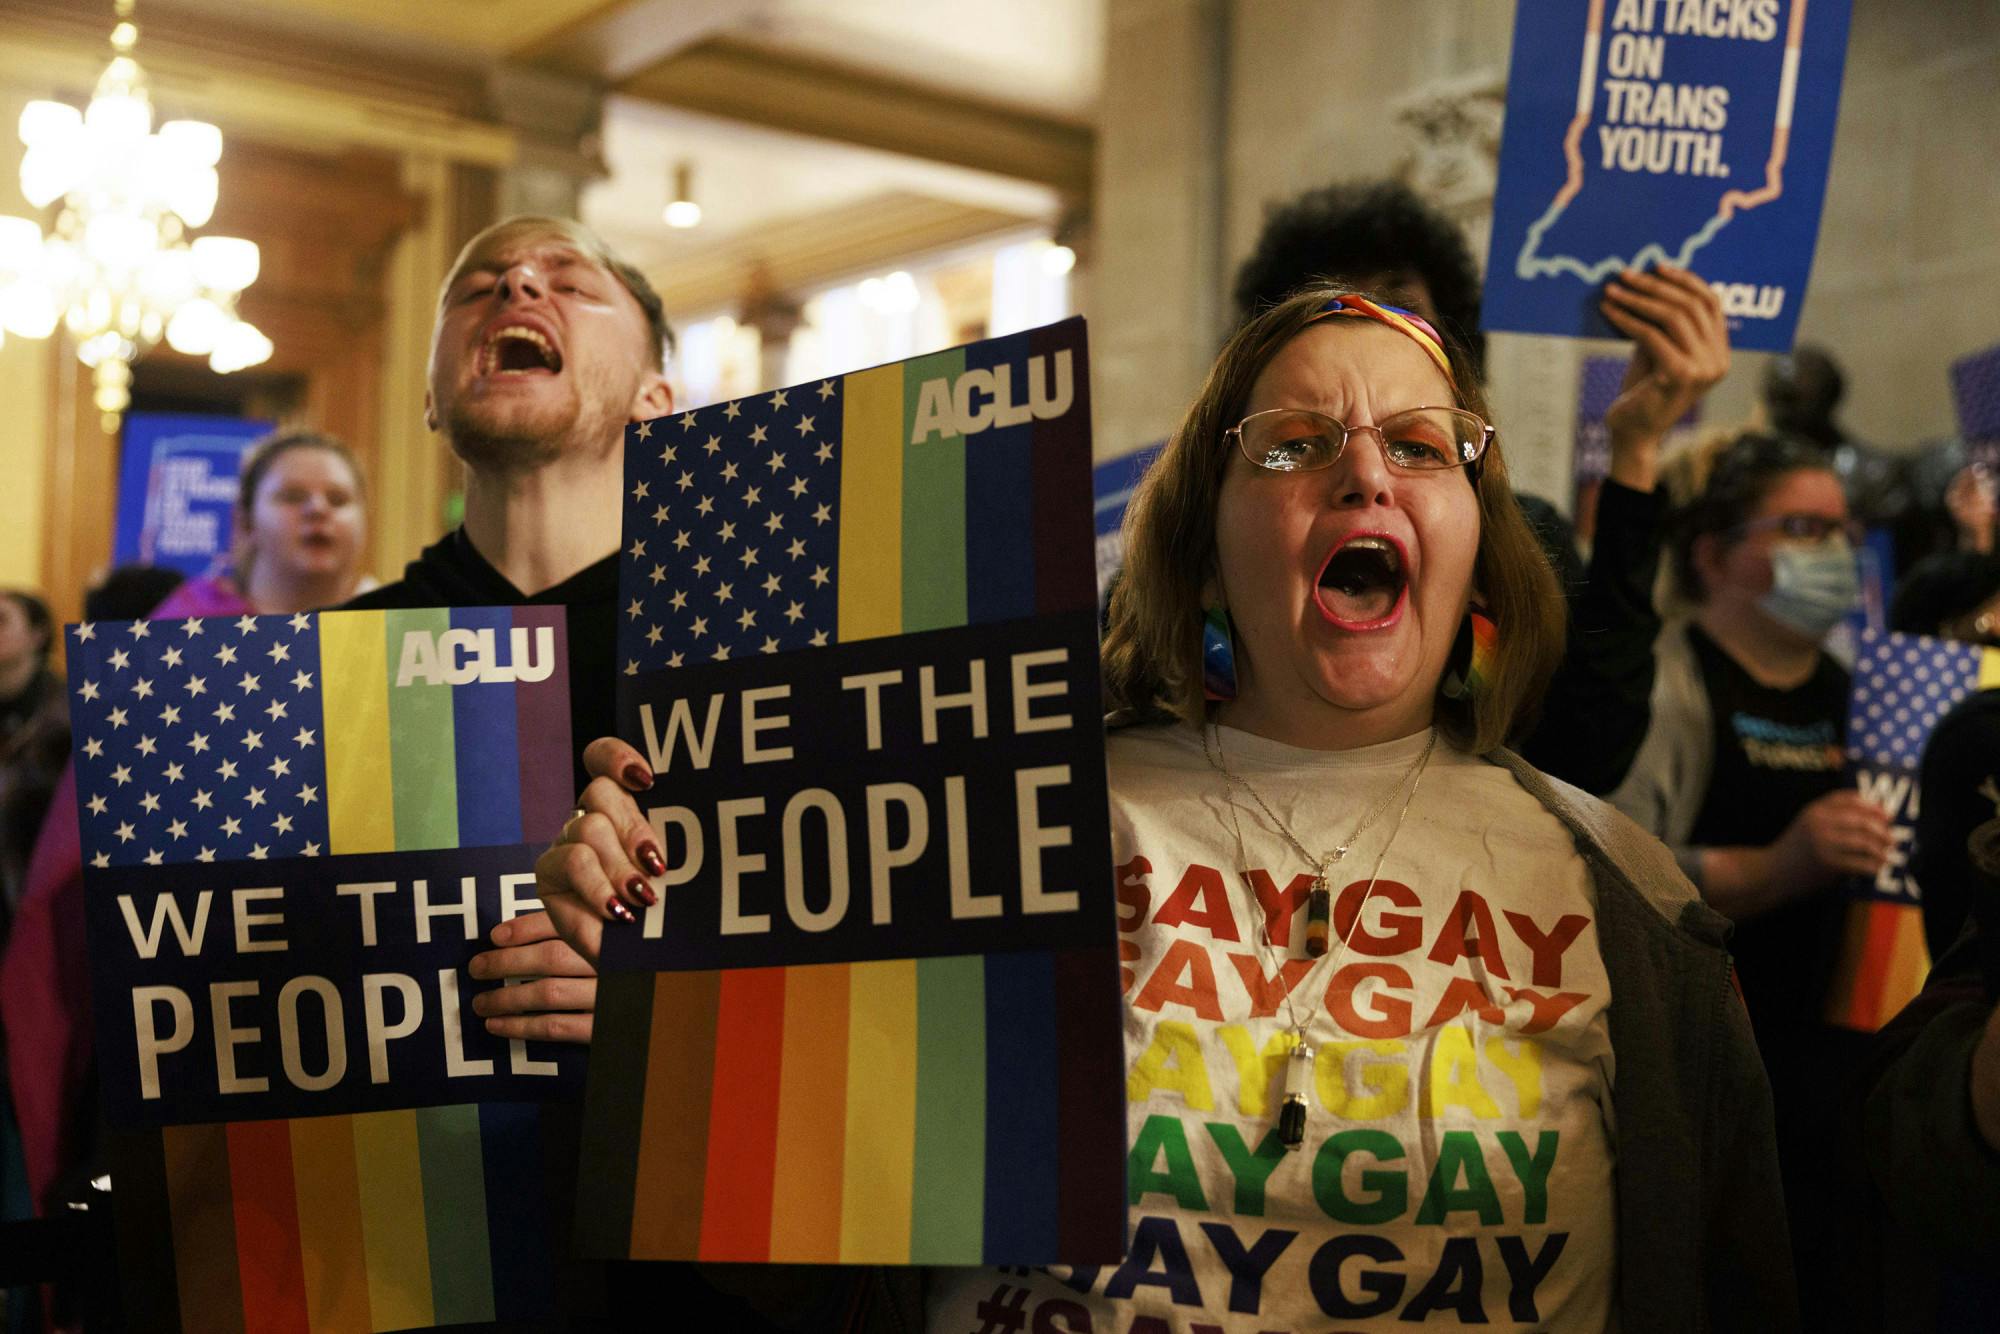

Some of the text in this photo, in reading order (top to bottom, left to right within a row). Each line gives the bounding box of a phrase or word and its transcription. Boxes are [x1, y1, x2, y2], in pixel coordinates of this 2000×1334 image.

[1612, 0, 1780, 41] ATTACKS
[1606, 34, 1665, 79] ON
[1604, 81, 1730, 131] TRANS
[1599, 126, 1730, 178] YOUTH.
[911, 349, 1075, 445] ACLU
[396, 627, 555, 687] ACLU
[640, 648, 1073, 775] WE THE
[642, 764, 1080, 939] PEOPLE
[117, 887, 288, 959] WE
